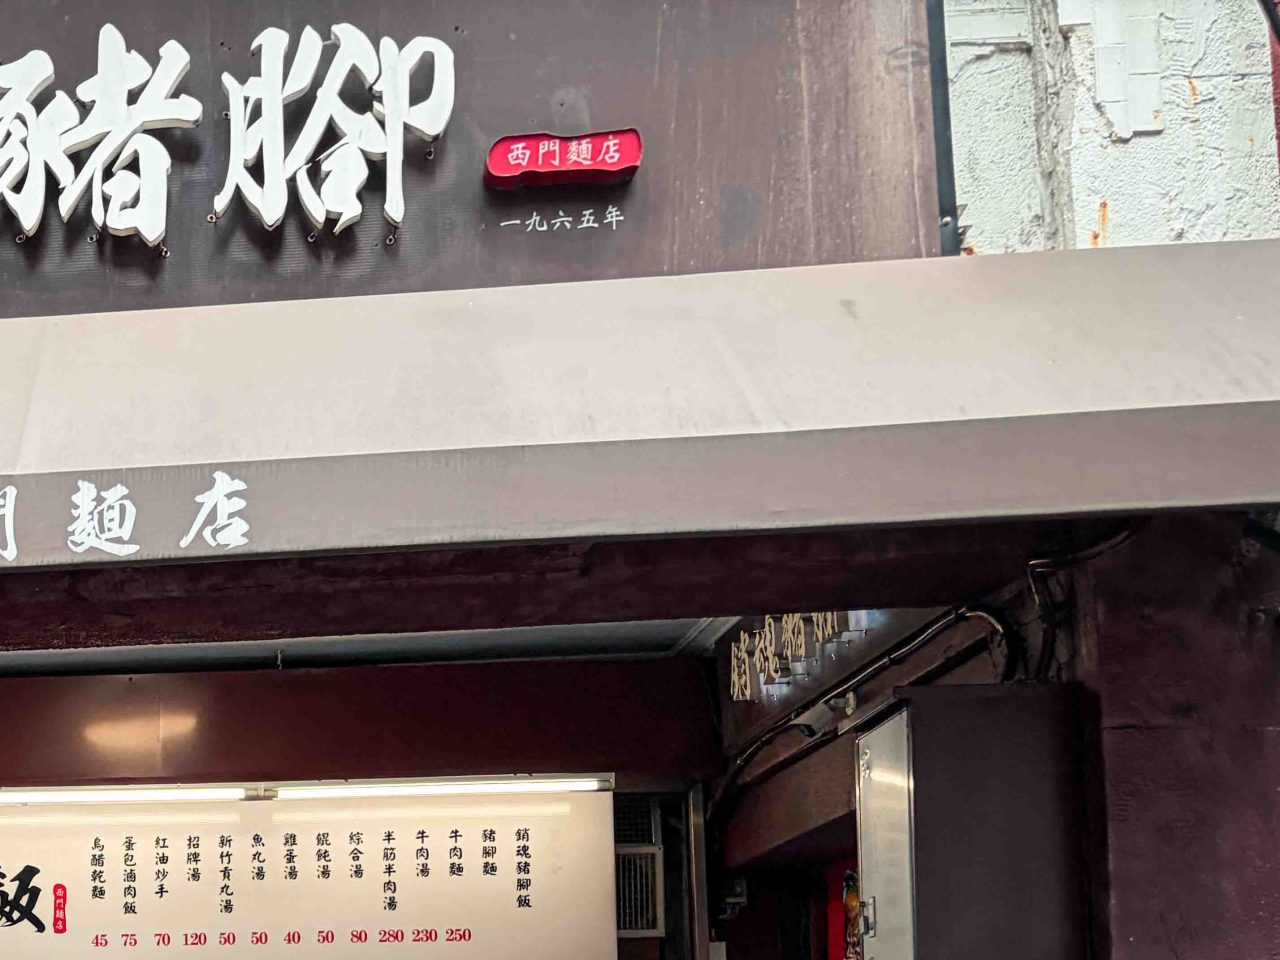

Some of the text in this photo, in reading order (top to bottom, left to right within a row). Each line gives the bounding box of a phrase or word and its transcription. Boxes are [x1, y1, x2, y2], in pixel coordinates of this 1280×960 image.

[507, 136, 621, 167] 西門麵店
[500, 205, 625, 232] 一九六五年
[186, 835, 202, 882] 招牌湯
[251, 833, 266, 881] 魚丸湯
[283, 832, 299, 880] 雞蛋湯
[315, 832, 332, 880] 餛飩湯
[348, 831, 364, 879] 綜合湯
[415, 829, 431, 878] 牛肉湯
[449, 829, 464, 877] 牛肉麵
[482, 828, 498, 876] 豬腳麵
[90, 836, 106, 900] 烏醋乾麵
[122, 836, 138, 915] 蛋包滷肉飯
[218, 834, 234, 914] 新竹貢丸湯
[382, 830, 398, 911] 半筋半肉湯
[515, 827, 533, 909] 銷魂豬腳飯
[91, 934, 108, 947] 45
[121, 933, 138, 947] 75
[154, 933, 171, 946] 70
[182, 932, 208, 946] 120
[218, 932, 236, 946] 50
[251, 931, 268, 945] 50
[283, 930, 301, 945] 40
[317, 930, 335, 944] 50
[350, 929, 368, 944] 80
[378, 928, 405, 943] 280
[412, 928, 438, 943] 230
[445, 928, 472, 943] 250
